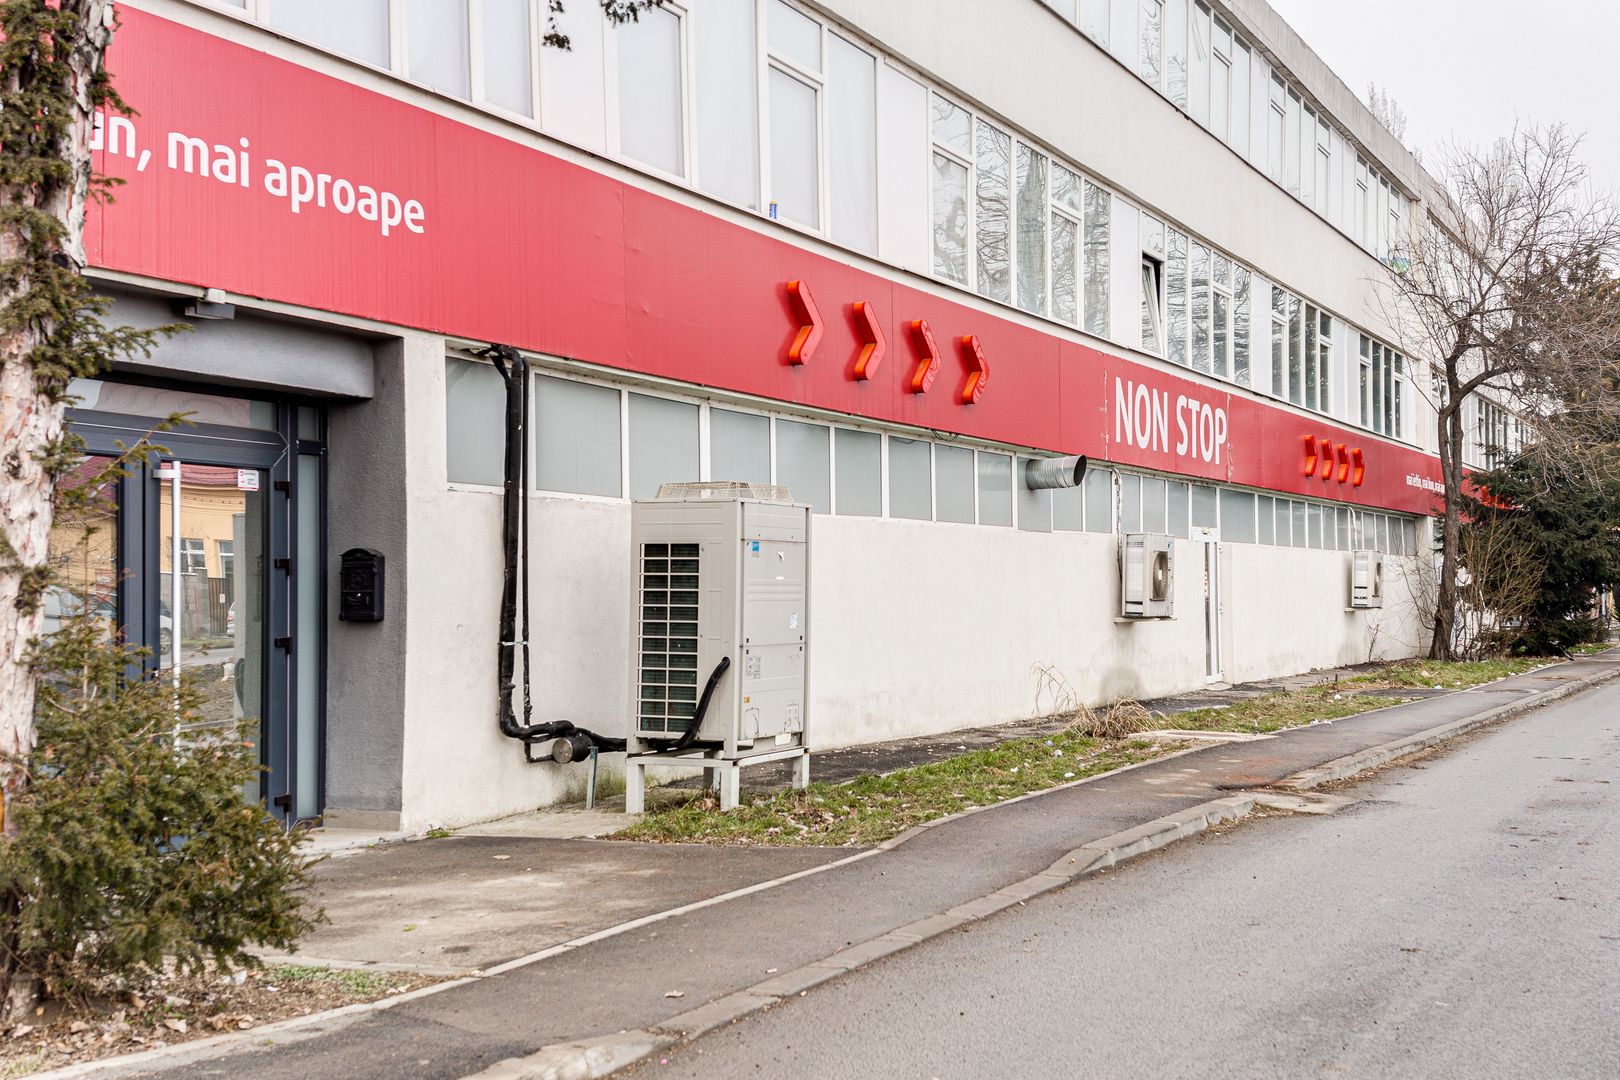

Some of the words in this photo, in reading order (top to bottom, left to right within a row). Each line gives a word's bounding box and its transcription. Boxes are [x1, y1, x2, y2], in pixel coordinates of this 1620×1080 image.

[168, 132, 249, 188] mai
[264, 159, 425, 236] aproape
[1115, 376, 1169, 454] NON
[1176, 394, 1228, 465] STOP
